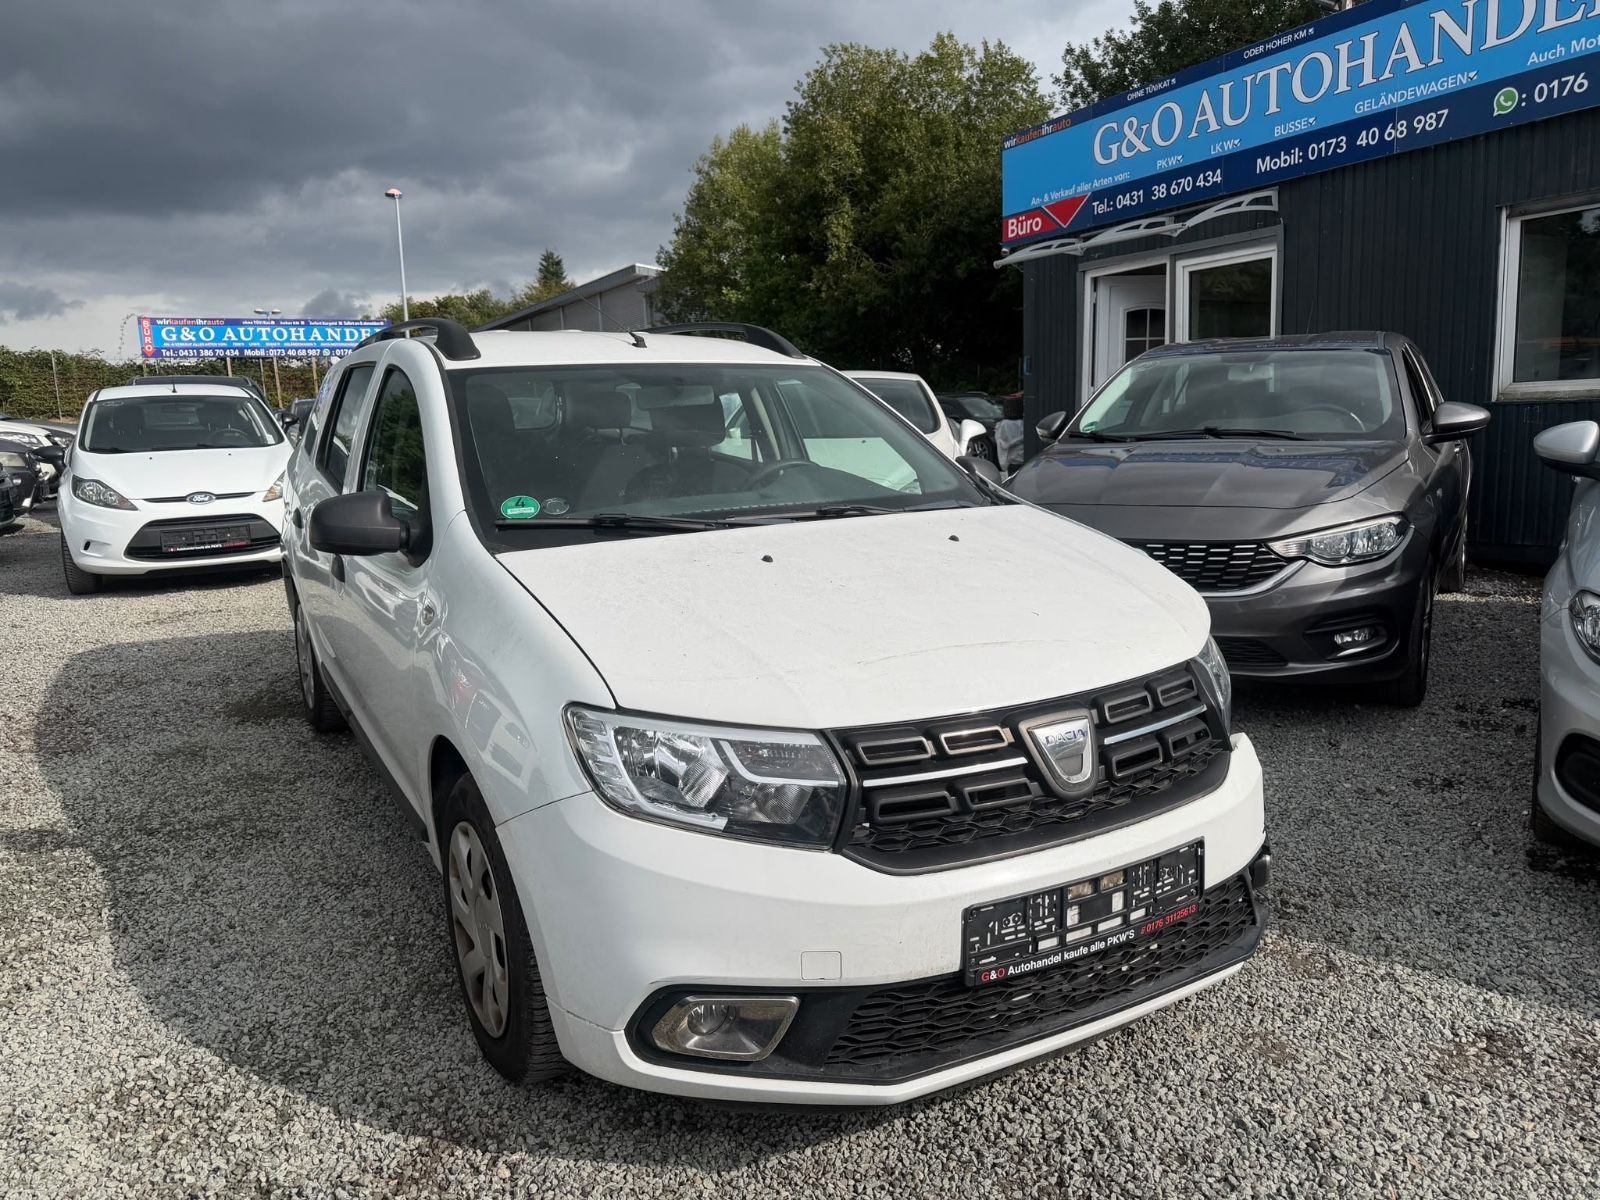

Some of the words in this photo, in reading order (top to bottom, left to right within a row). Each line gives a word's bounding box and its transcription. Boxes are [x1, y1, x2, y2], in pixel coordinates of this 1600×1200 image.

[1243, 45, 1265, 59] ODER
[1265, 36, 1293, 51] HOHER
[1294, 31, 1307, 41] KM
[1527, 43, 1565, 66] Auch
[1093, 101, 1183, 166] G&O
[1188, 0, 1600, 138] AUTOHANDE
[1354, 72, 1467, 114] GELÄNDEWAGEN
[1534, 72, 1589, 103] 0176
[1127, 89, 1145, 101] OHNE
[1003, 118, 1072, 149] wirkaufenihrauto
[1274, 118, 1308, 137] BUSSE
[1210, 139, 1235, 155] LKW
[1256, 147, 1303, 174] Mobil:
[1308, 135, 1347, 161] 0173
[1356, 127, 1379, 148] 40
[1384, 120, 1407, 142] 68
[1413, 108, 1449, 134] 987
[1156, 156, 1178, 170] PKW
[1049, 185, 1076, 200] Verkauf
[1076, 182, 1092, 195] aller
[1092, 176, 1113, 188] Arten
[1113, 171, 1131, 184] von:
[1092, 198, 1114, 215] Tel.:
[1116, 189, 1144, 209] 0431
[1151, 183, 1167, 201] 38
[1170, 176, 1193, 196] 670
[1196, 168, 1222, 188] 434
[1007, 216, 1042, 238] Büro
[156, 318, 225, 326] wirkaufenihrauto
[161, 327, 215, 342] G&O
[222, 327, 383, 342] AUTOHANDE
[225, 349, 239, 357] 434
[515, 497, 525, 508] 4
[1045, 728, 1087, 746] DACIA
[981, 966, 1005, 982] G&O
[1007, 951, 1062, 976] Autohandel
[1063, 945, 1088, 963] kaufe
[1089, 939, 1106, 953] alle
[1107, 929, 1135, 947] PKW'S
[1146, 918, 1164, 932] 0176
